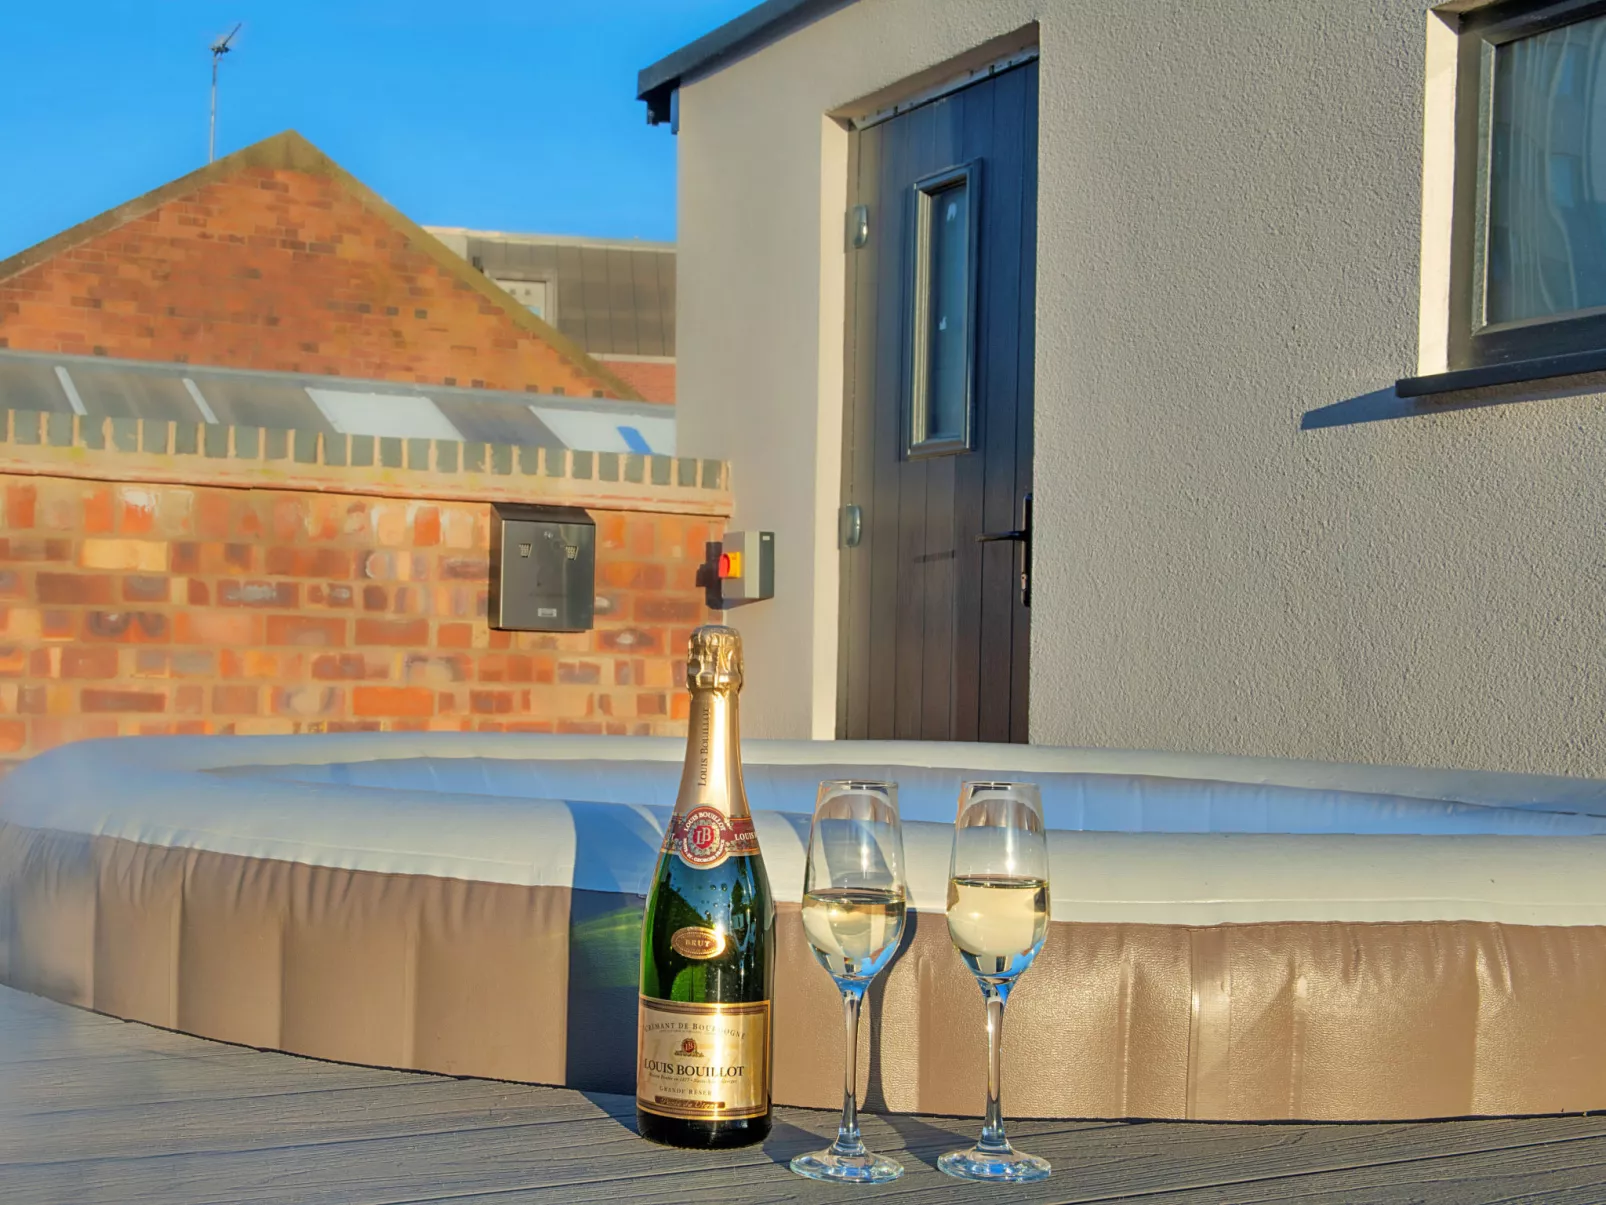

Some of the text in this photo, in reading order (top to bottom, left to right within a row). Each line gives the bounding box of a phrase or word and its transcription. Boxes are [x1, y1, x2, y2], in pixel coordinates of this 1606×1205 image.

[698, 708, 709, 786] LOUIS BOUILLOT
[684, 811, 726, 832] LOUIS BOUILLOT
[696, 826, 712, 845] LB
[734, 832, 755, 841] LOUIS
[685, 939, 711, 948] BRUT
[678, 1022, 689, 1030] DE
[692, 1023, 746, 1040] BOUROGNE
[644, 1058, 745, 1078] LOUIS BOUILLOT
